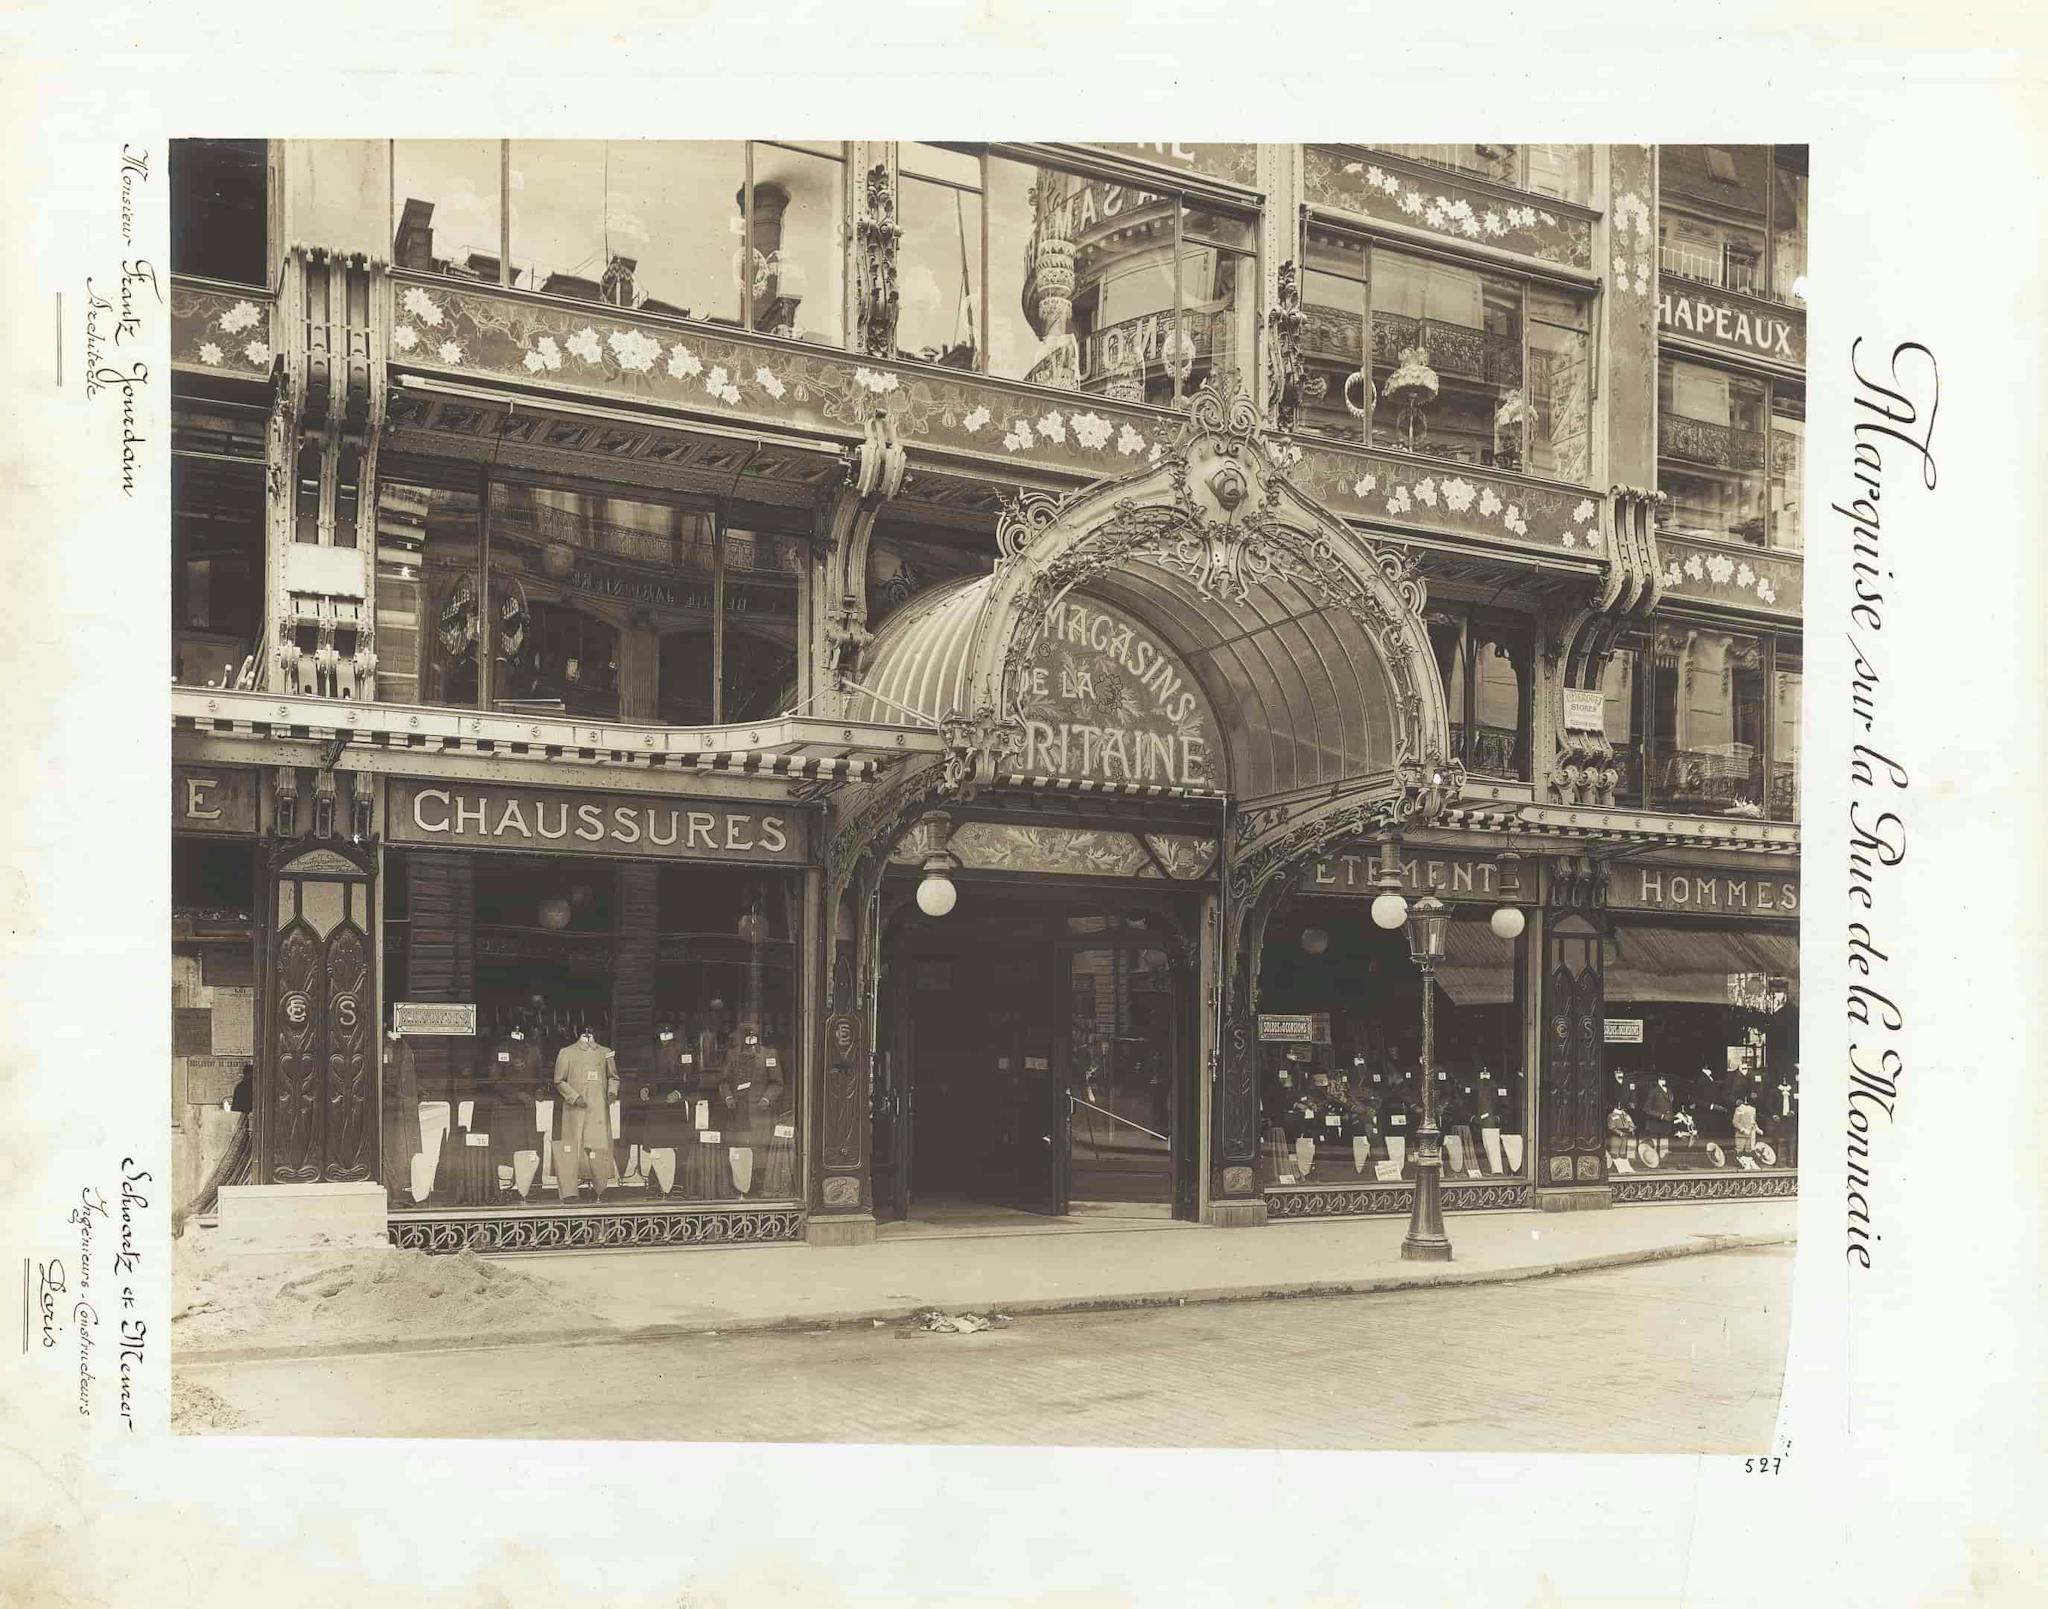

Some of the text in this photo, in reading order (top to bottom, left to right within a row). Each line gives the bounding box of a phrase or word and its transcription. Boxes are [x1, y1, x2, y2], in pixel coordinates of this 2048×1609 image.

[87, 277, 113, 398] Architecte
[95, 144, 162, 496] Monsieur Frantz Jourdain
[1043, 602, 1196, 722] MAGASINS
[1062, 671, 1096, 699] LA
[413, 789, 787, 852] CHAUSSURES
[1832, 336, 1938, 1269] Marquise sur la Rue de la Monnaie
[1315, 855, 1519, 892] ETEMENT
[1640, 870, 1797, 909] HOMMES
[114, 1158, 152, 1275] Schwartz
[40, 1259, 66, 1347] Paris
[1746, 1458, 1781, 1475] 527
